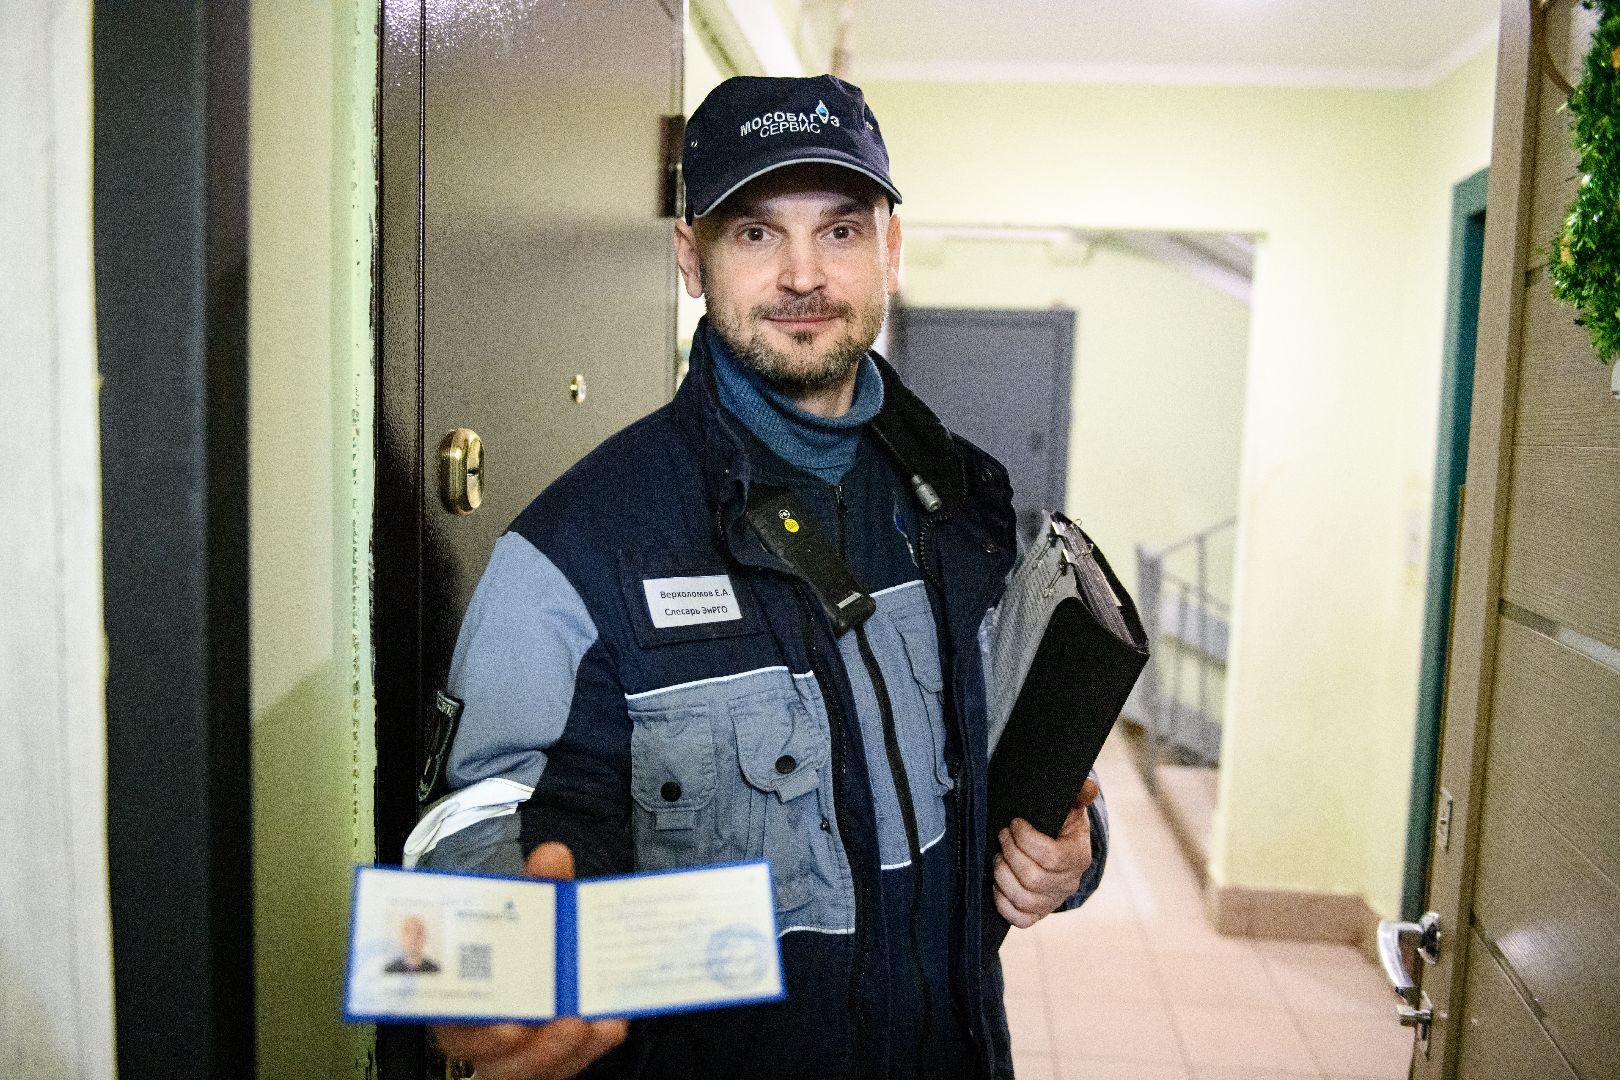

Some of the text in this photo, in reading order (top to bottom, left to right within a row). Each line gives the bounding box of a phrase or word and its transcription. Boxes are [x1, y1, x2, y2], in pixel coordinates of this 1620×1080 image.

[760, 121, 821, 138] СЕРВИС
[660, 588, 731, 599] Верхоломов Е.А.
[664, 608, 701, 616] Слесарь
